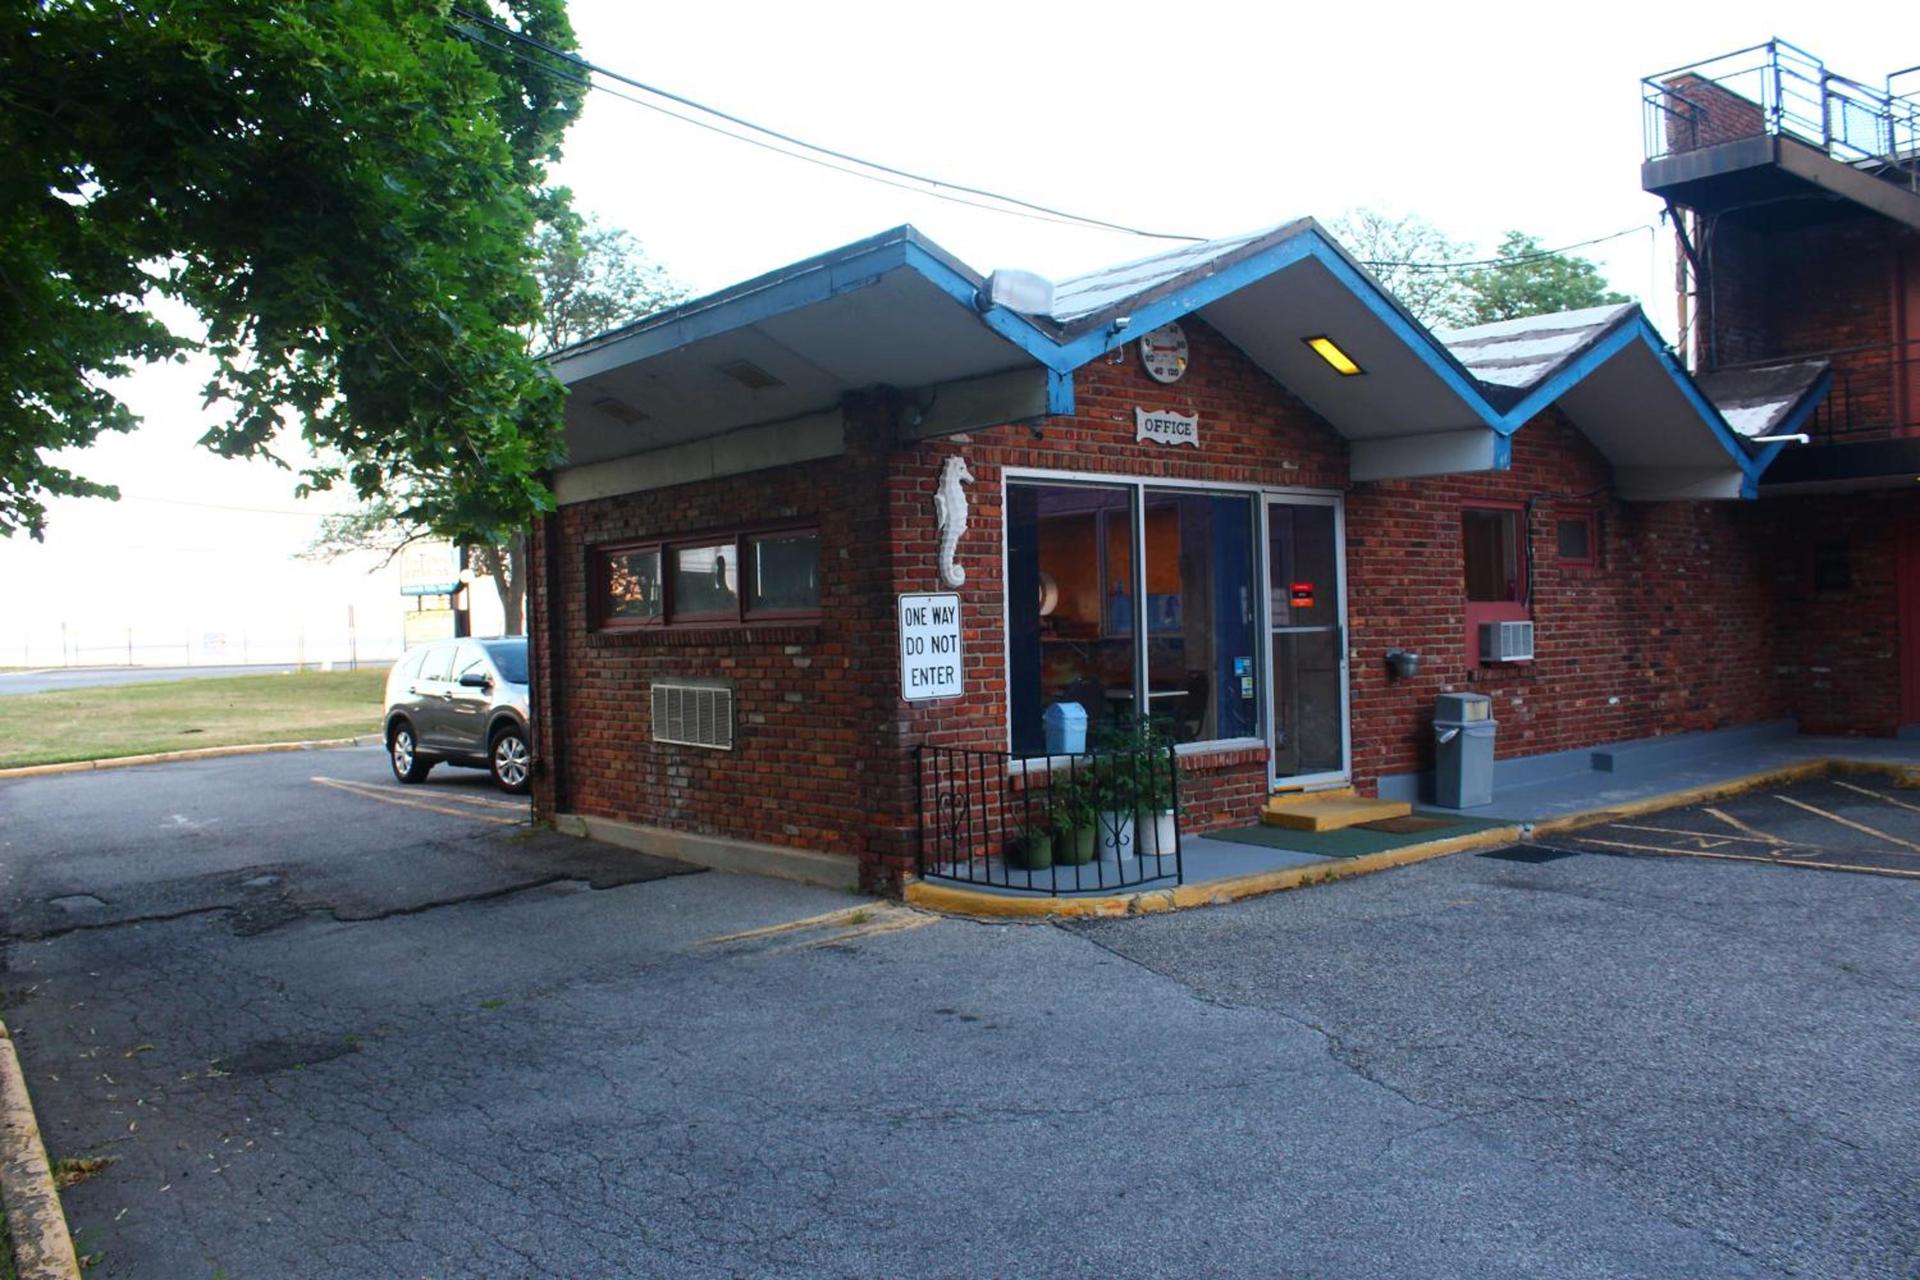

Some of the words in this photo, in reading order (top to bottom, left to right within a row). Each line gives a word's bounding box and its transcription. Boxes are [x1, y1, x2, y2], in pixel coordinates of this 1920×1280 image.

[1144, 418, 1192, 436] OFFICE
[905, 607, 927, 626] ONE
[931, 606, 956, 625] WAY
[906, 636, 924, 656] DO
[931, 634, 957, 654] NOT
[911, 665, 955, 687] ENTER
